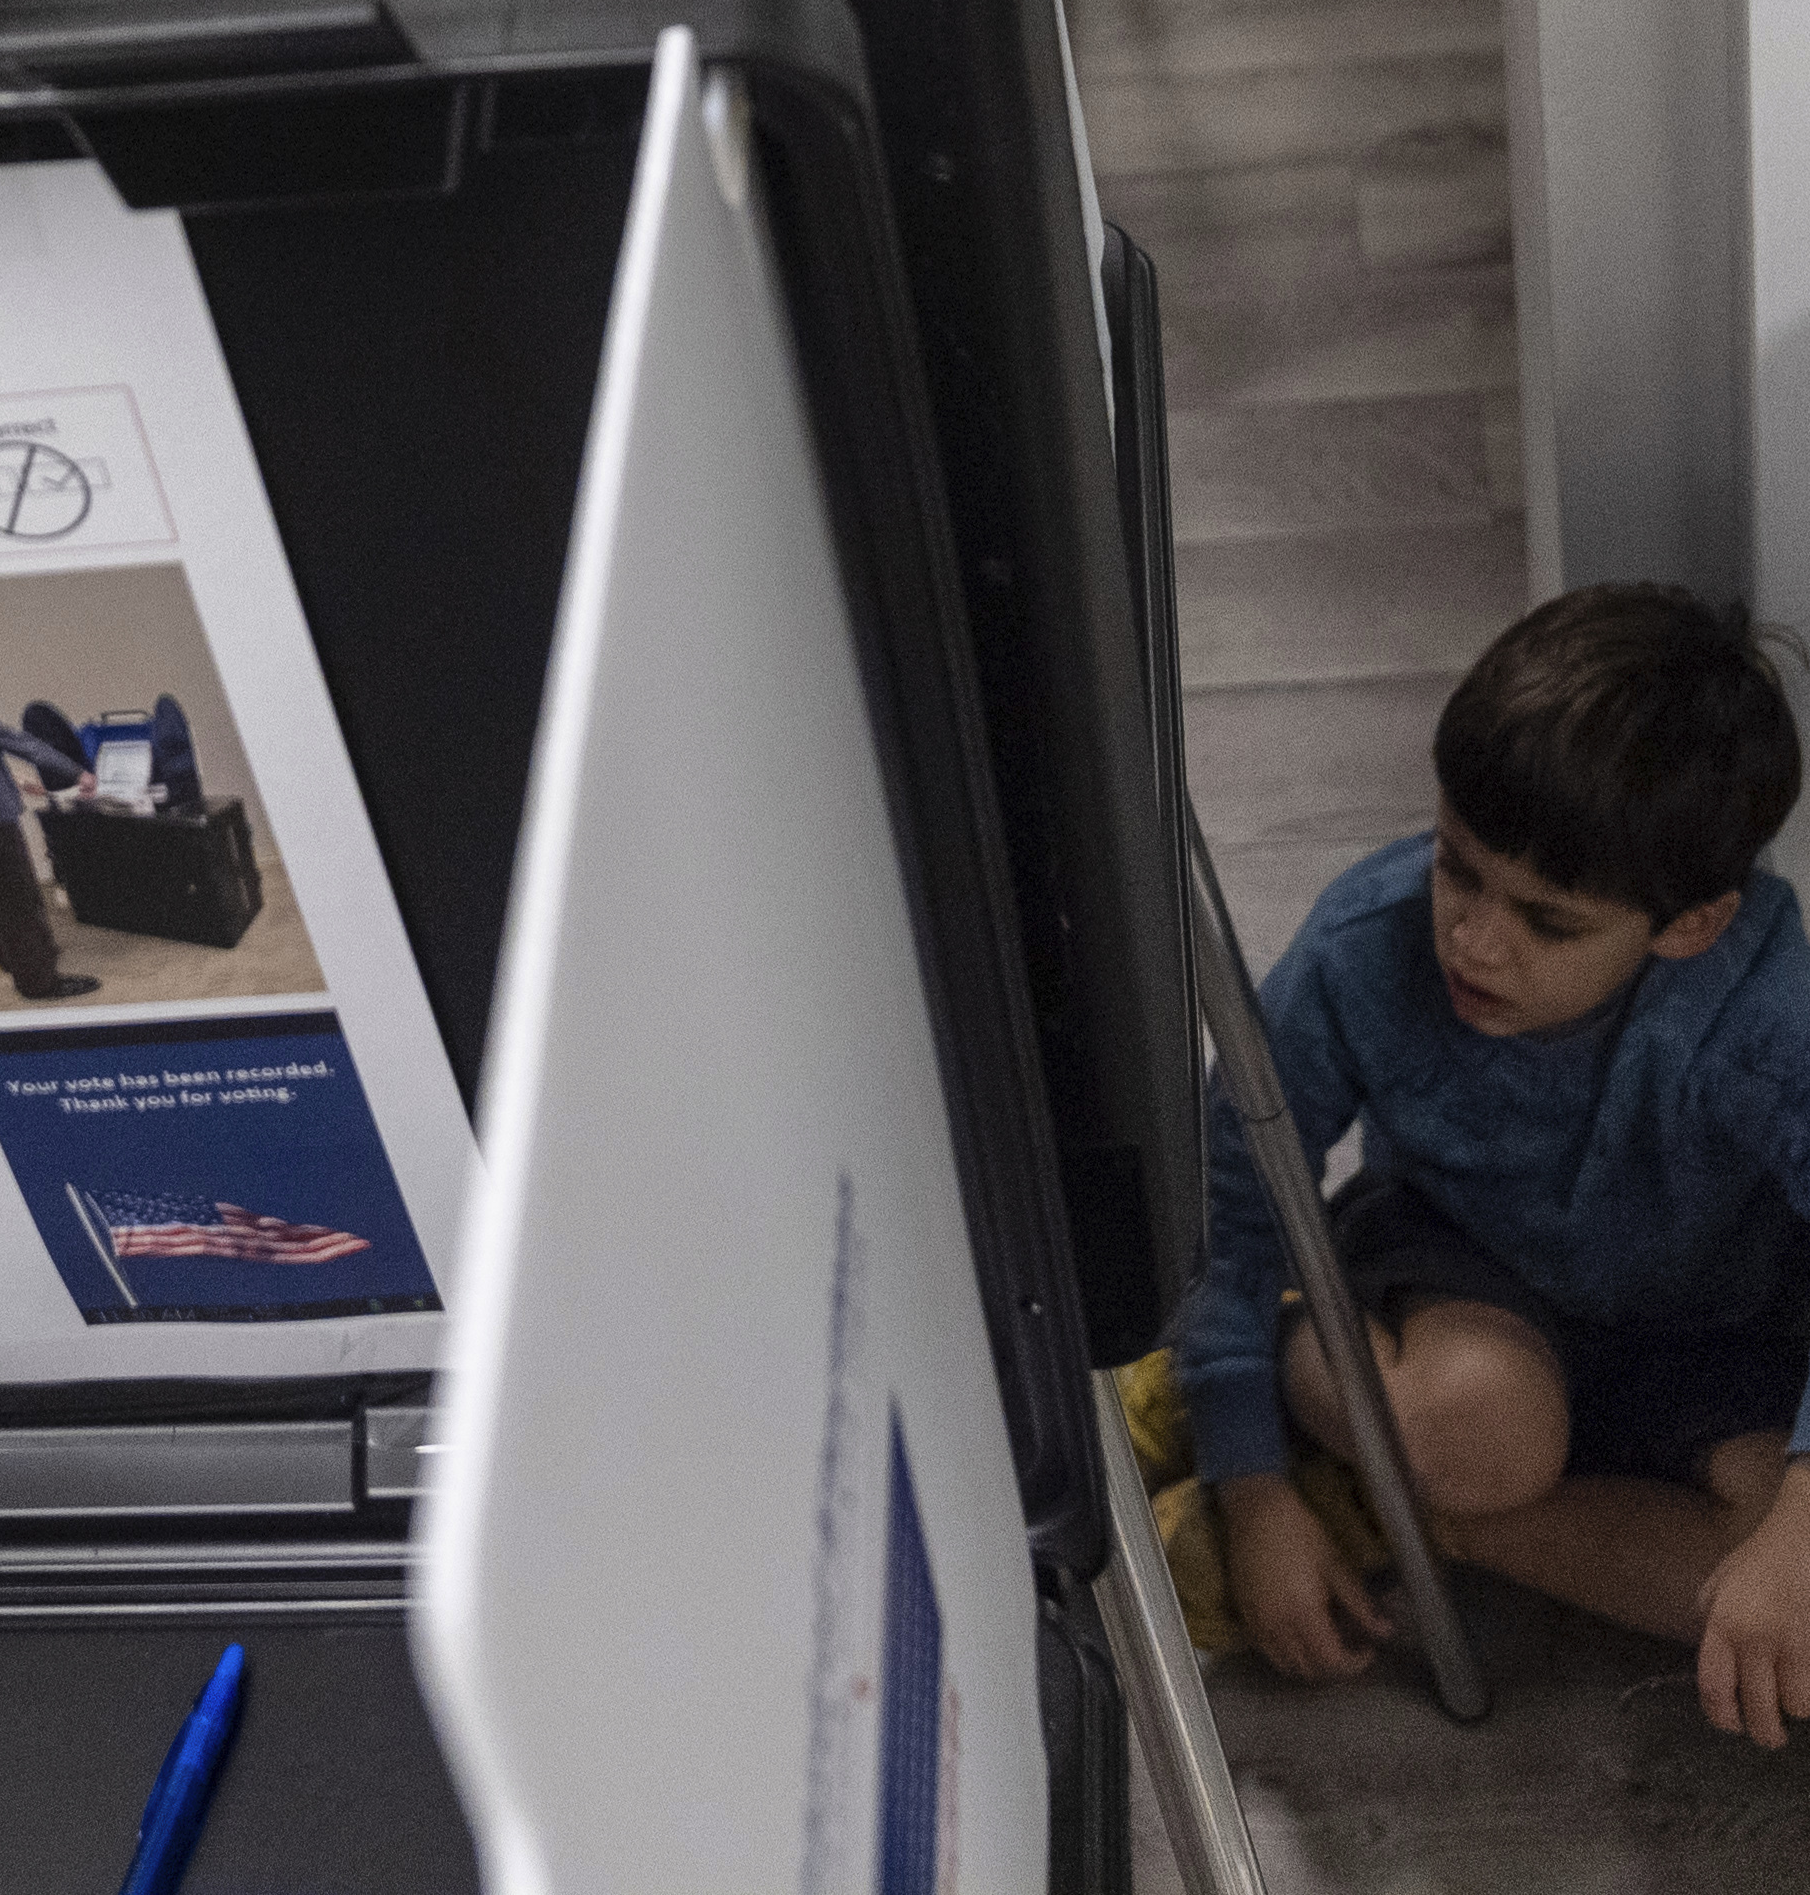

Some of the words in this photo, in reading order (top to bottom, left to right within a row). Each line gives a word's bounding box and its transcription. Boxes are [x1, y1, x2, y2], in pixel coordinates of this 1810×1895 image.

[6, 1079, 58, 1095] Your
[65, 1076, 115, 1092] vote
[118, 1073, 159, 1089] has
[162, 1069, 221, 1088] been
[225, 1060, 335, 1082] recorded.
[59, 1095, 129, 1114] Thank
[134, 1093, 176, 1112] you
[179, 1089, 213, 1105] for
[218, 1085, 296, 1105] voting.
